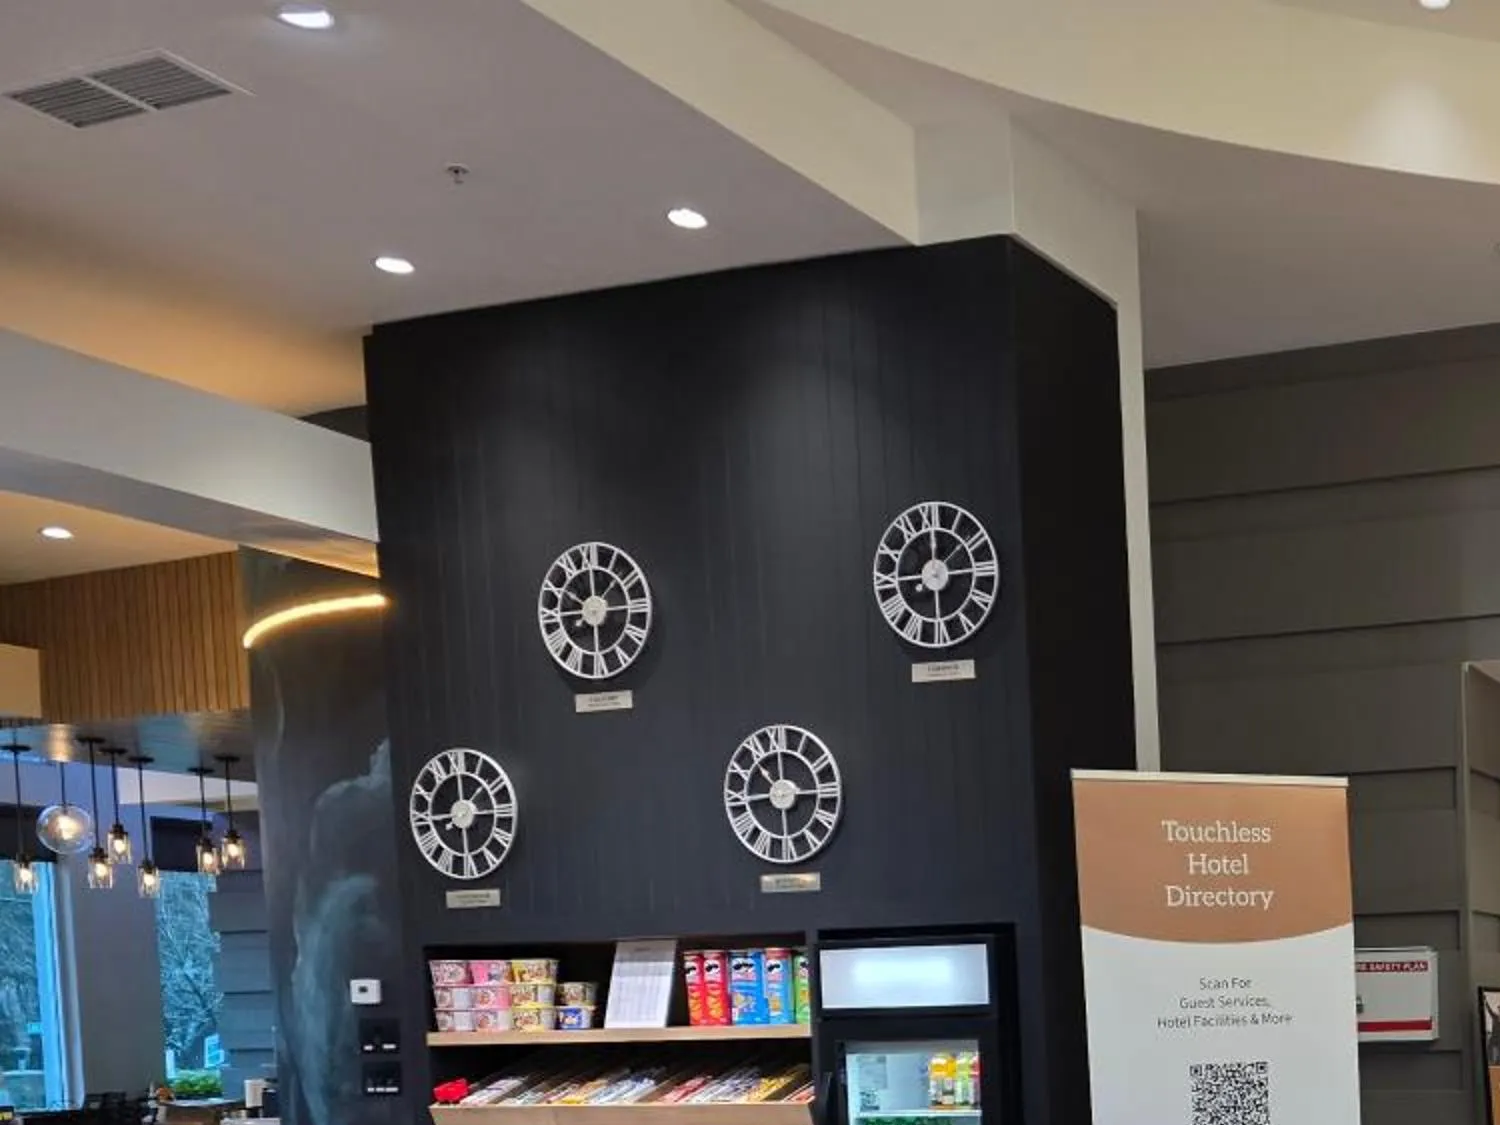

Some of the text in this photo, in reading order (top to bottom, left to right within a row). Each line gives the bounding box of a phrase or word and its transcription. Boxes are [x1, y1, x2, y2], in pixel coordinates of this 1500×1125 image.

[1161, 819, 1272, 843] Touchless
[1187, 853, 1249, 875] Hotel
[1166, 885, 1274, 911] Directory
[1369, 963, 1401, 972] SAFETY
[1402, 962, 1427, 972] PLAN
[1199, 977, 1252, 990] Scan For
[1180, 996, 1215, 1009] Guest
[1157, 1012, 1293, 1029] Hotel Facilities & More
